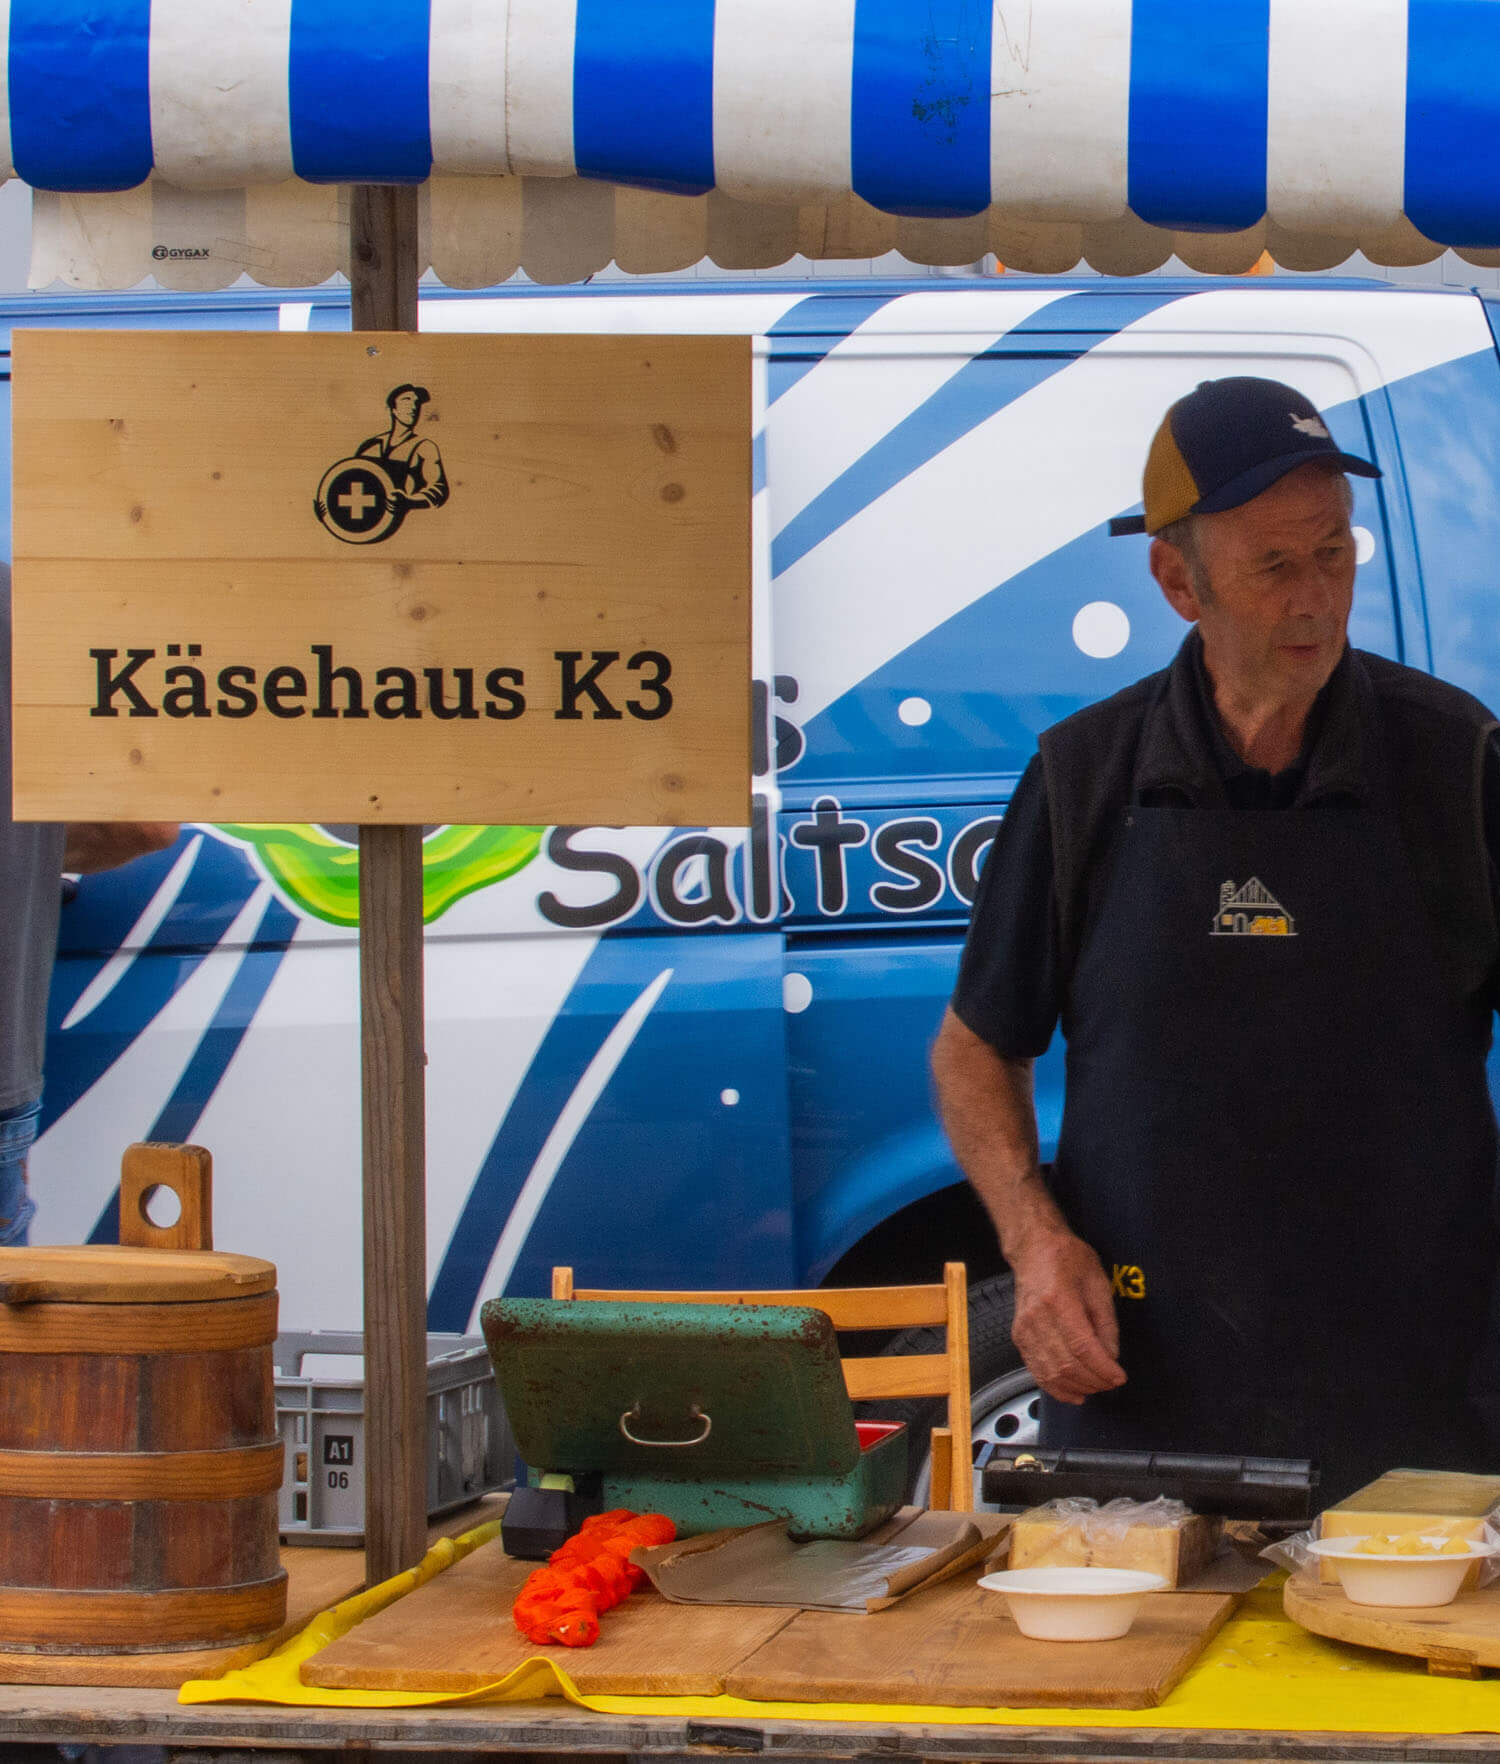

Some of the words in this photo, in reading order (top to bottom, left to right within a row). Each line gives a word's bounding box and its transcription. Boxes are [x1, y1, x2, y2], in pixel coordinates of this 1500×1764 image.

[169, 248, 210, 257] GYGAX
[89, 643, 527, 720] Käsehaus
[553, 650, 674, 720] K3
[1111, 1263, 1145, 1299] K3
[328, 1440, 350, 1460] A1
[327, 1471, 349, 1490] 06
